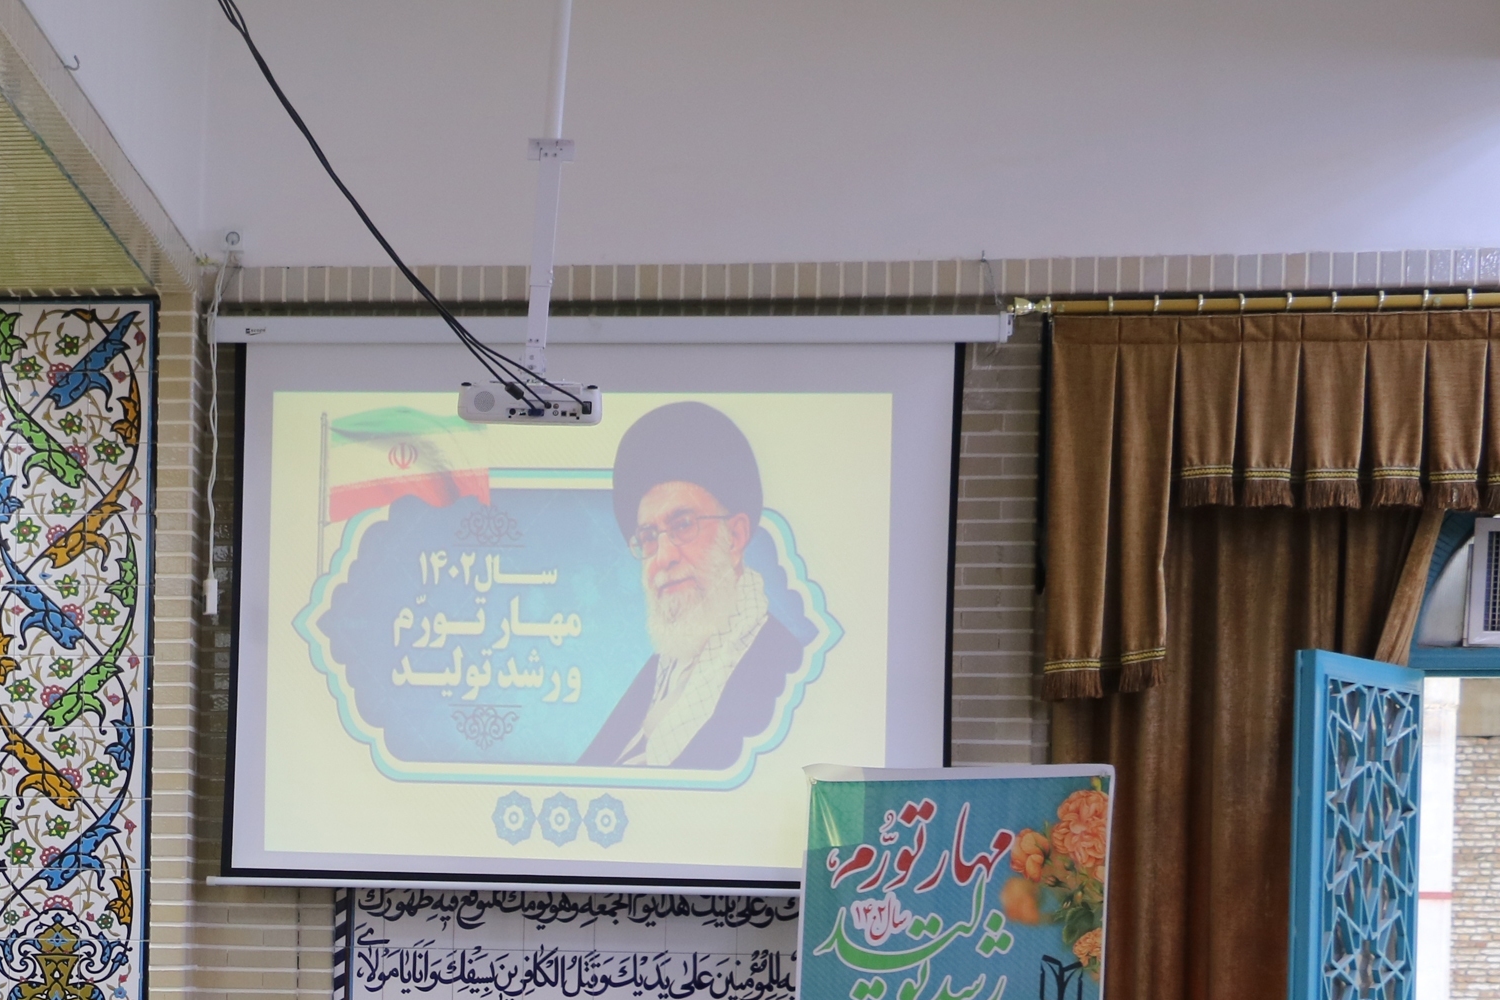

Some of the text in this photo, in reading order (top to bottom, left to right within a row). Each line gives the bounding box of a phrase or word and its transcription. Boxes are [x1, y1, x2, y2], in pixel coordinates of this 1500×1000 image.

[419, 550, 558, 592] سال ۱۴۰۲
[492, 595, 582, 649] مهار
[392, 645, 493, 700] تولید
[498, 649, 562, 702] رشد
